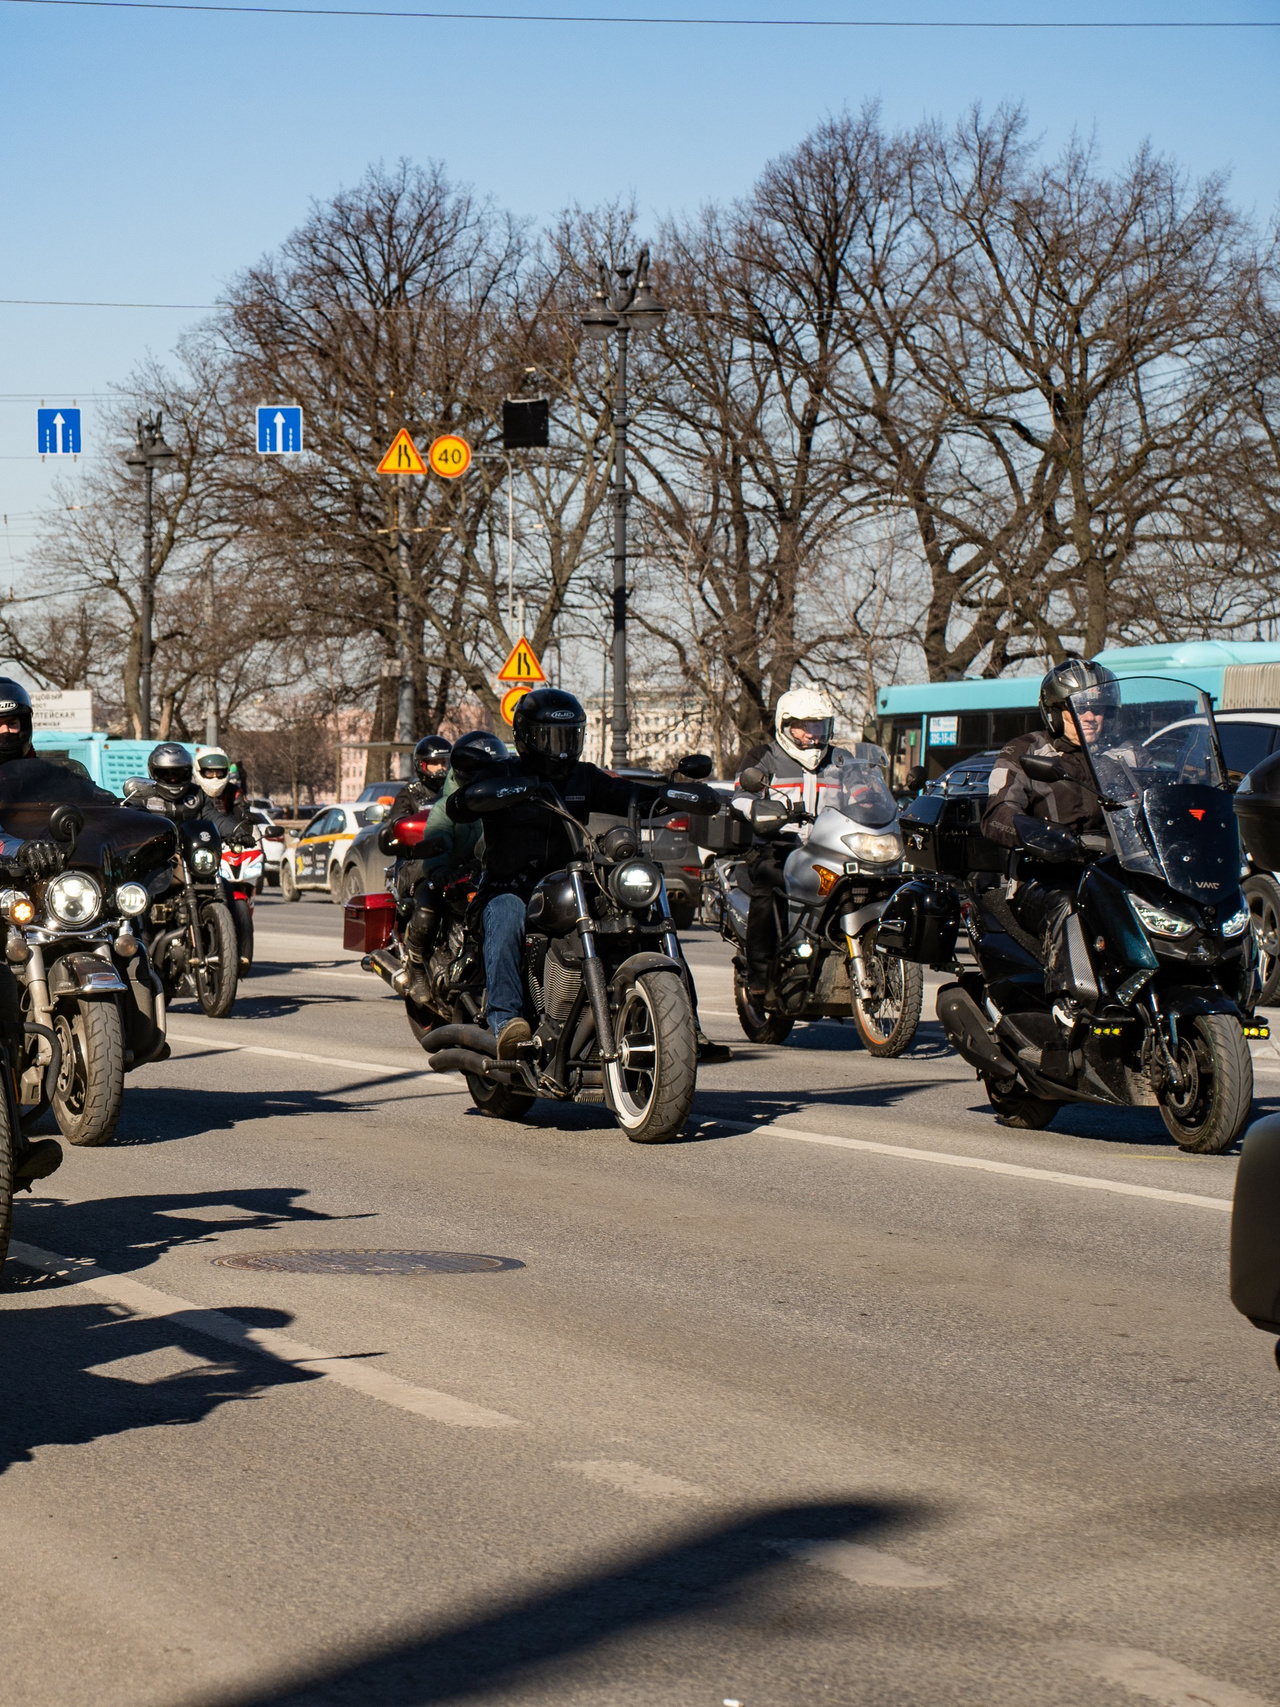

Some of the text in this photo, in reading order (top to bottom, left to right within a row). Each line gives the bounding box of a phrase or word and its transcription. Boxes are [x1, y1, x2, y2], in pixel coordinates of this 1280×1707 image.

[438, 448, 462, 464] 40
[31, 692, 63, 701] РЦОВЫЙ
[34, 711, 76, 719] ЛТЕЙСКАЯ
